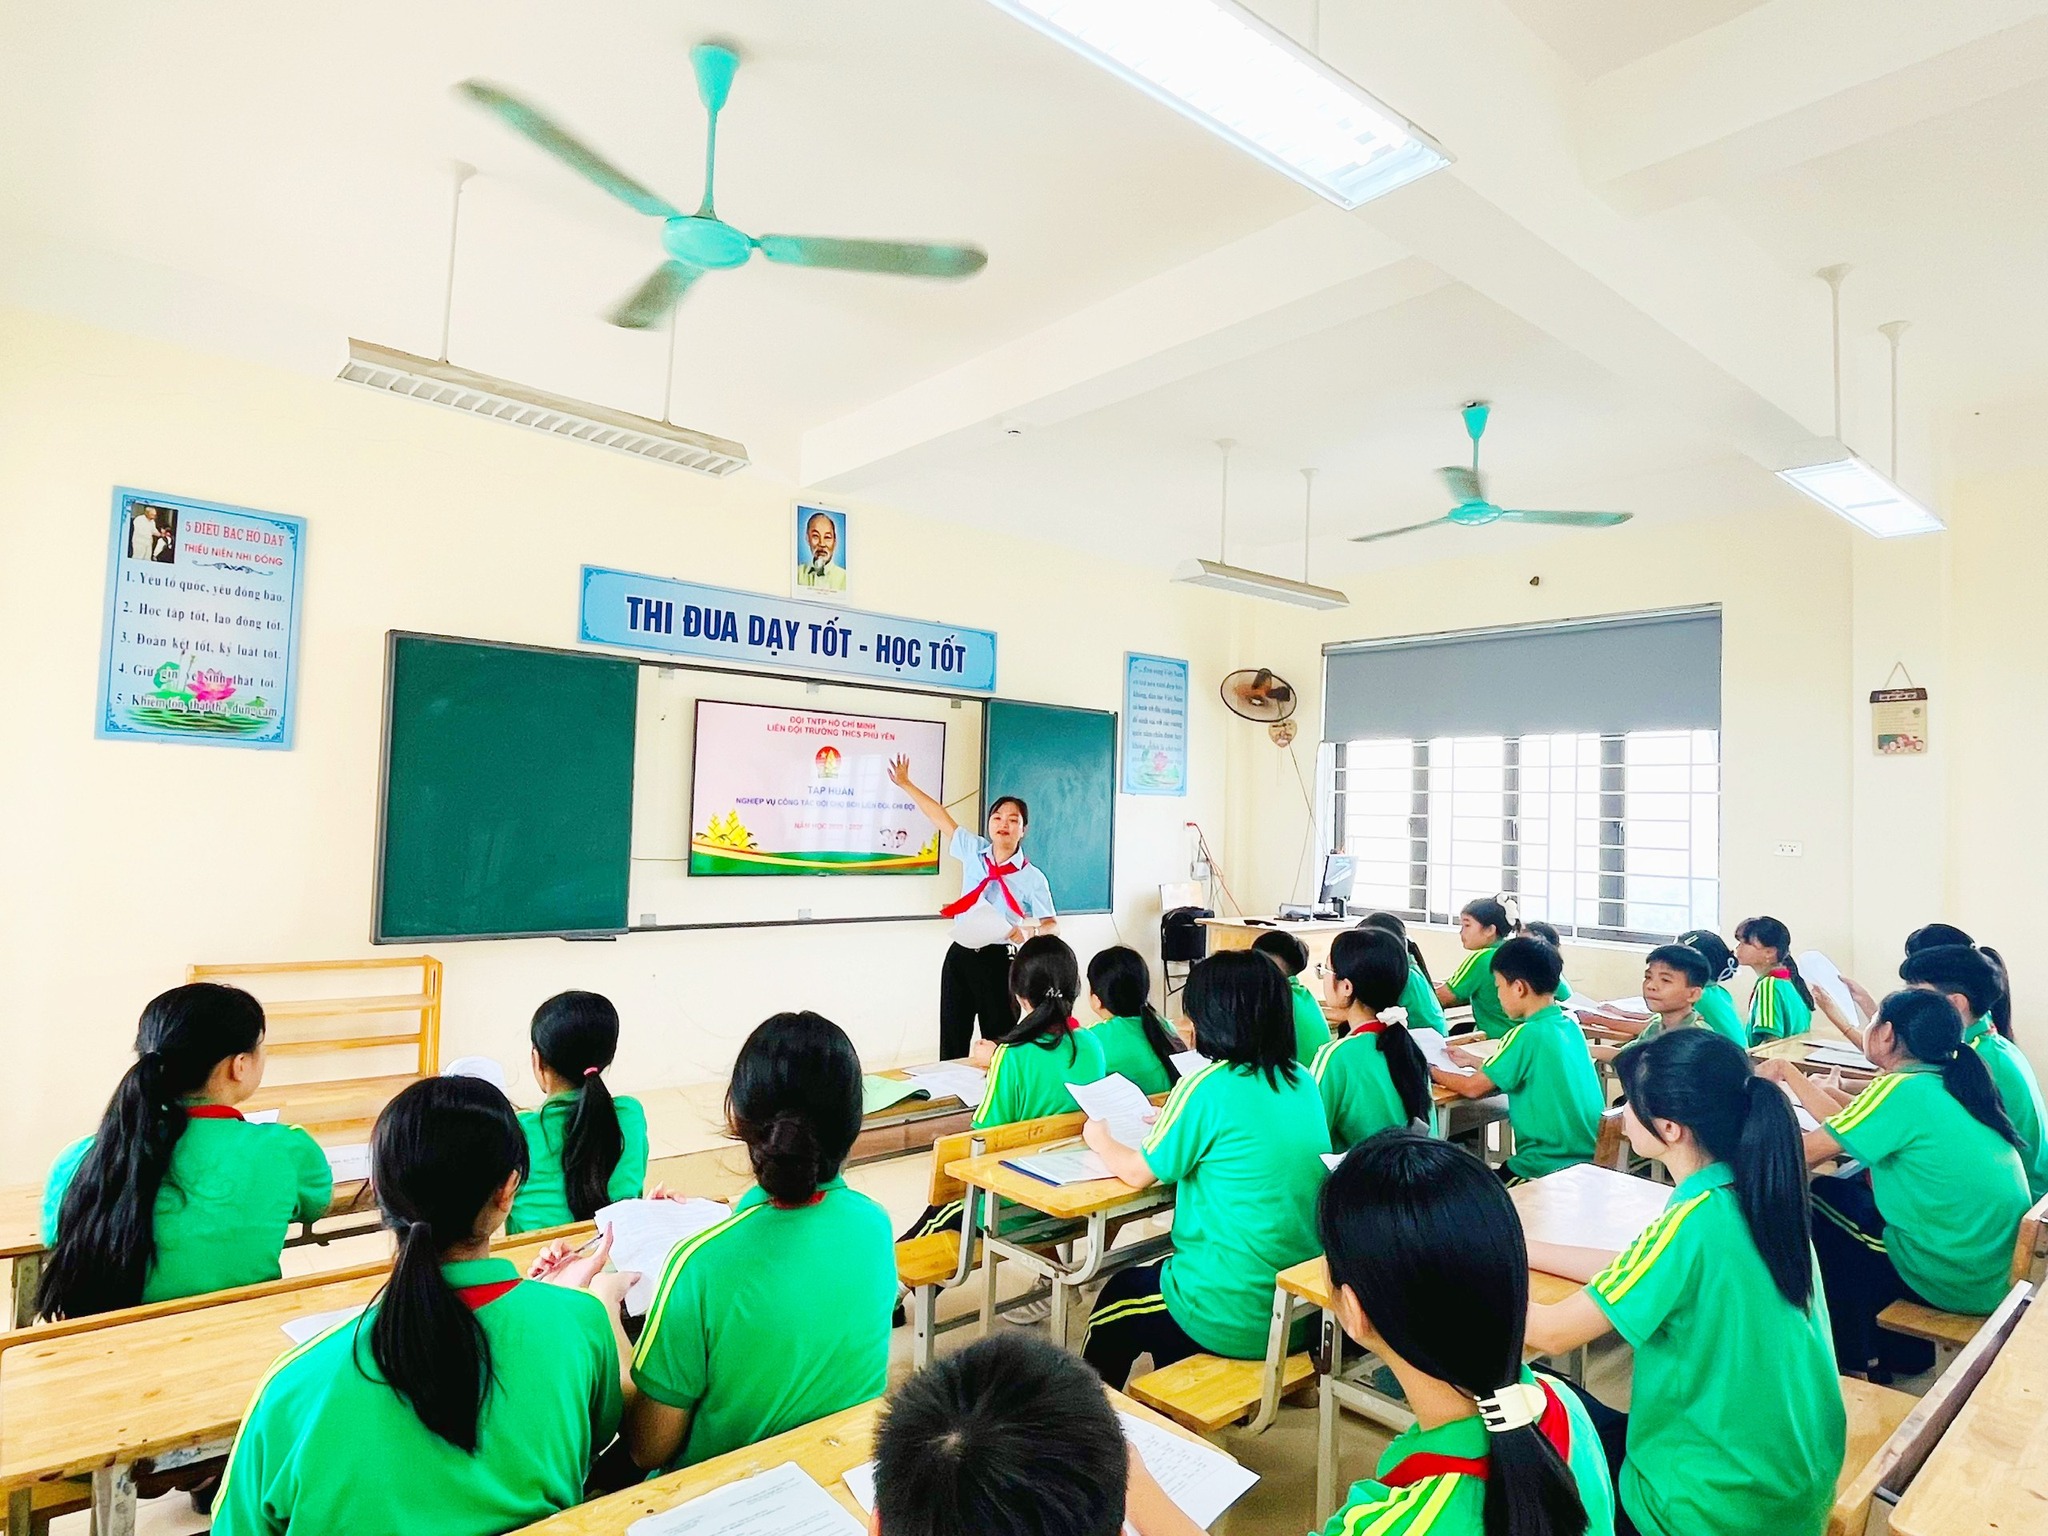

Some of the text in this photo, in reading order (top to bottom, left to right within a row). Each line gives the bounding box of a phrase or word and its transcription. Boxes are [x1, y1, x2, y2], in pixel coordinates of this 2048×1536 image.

[185, 521, 191, 532] 5
[626, 596, 673, 635] THI
[683, 604, 738, 643] ĐUA
[748, 614, 800, 656] DẠY
[808, 616, 852, 658] TỐT
[876, 634, 921, 671] HỌC
[929, 634, 966, 673] TỐT
[856, 722, 876, 730] MINH
[841, 729, 861, 738] THCS
[766, 798, 776, 807] VỤ
